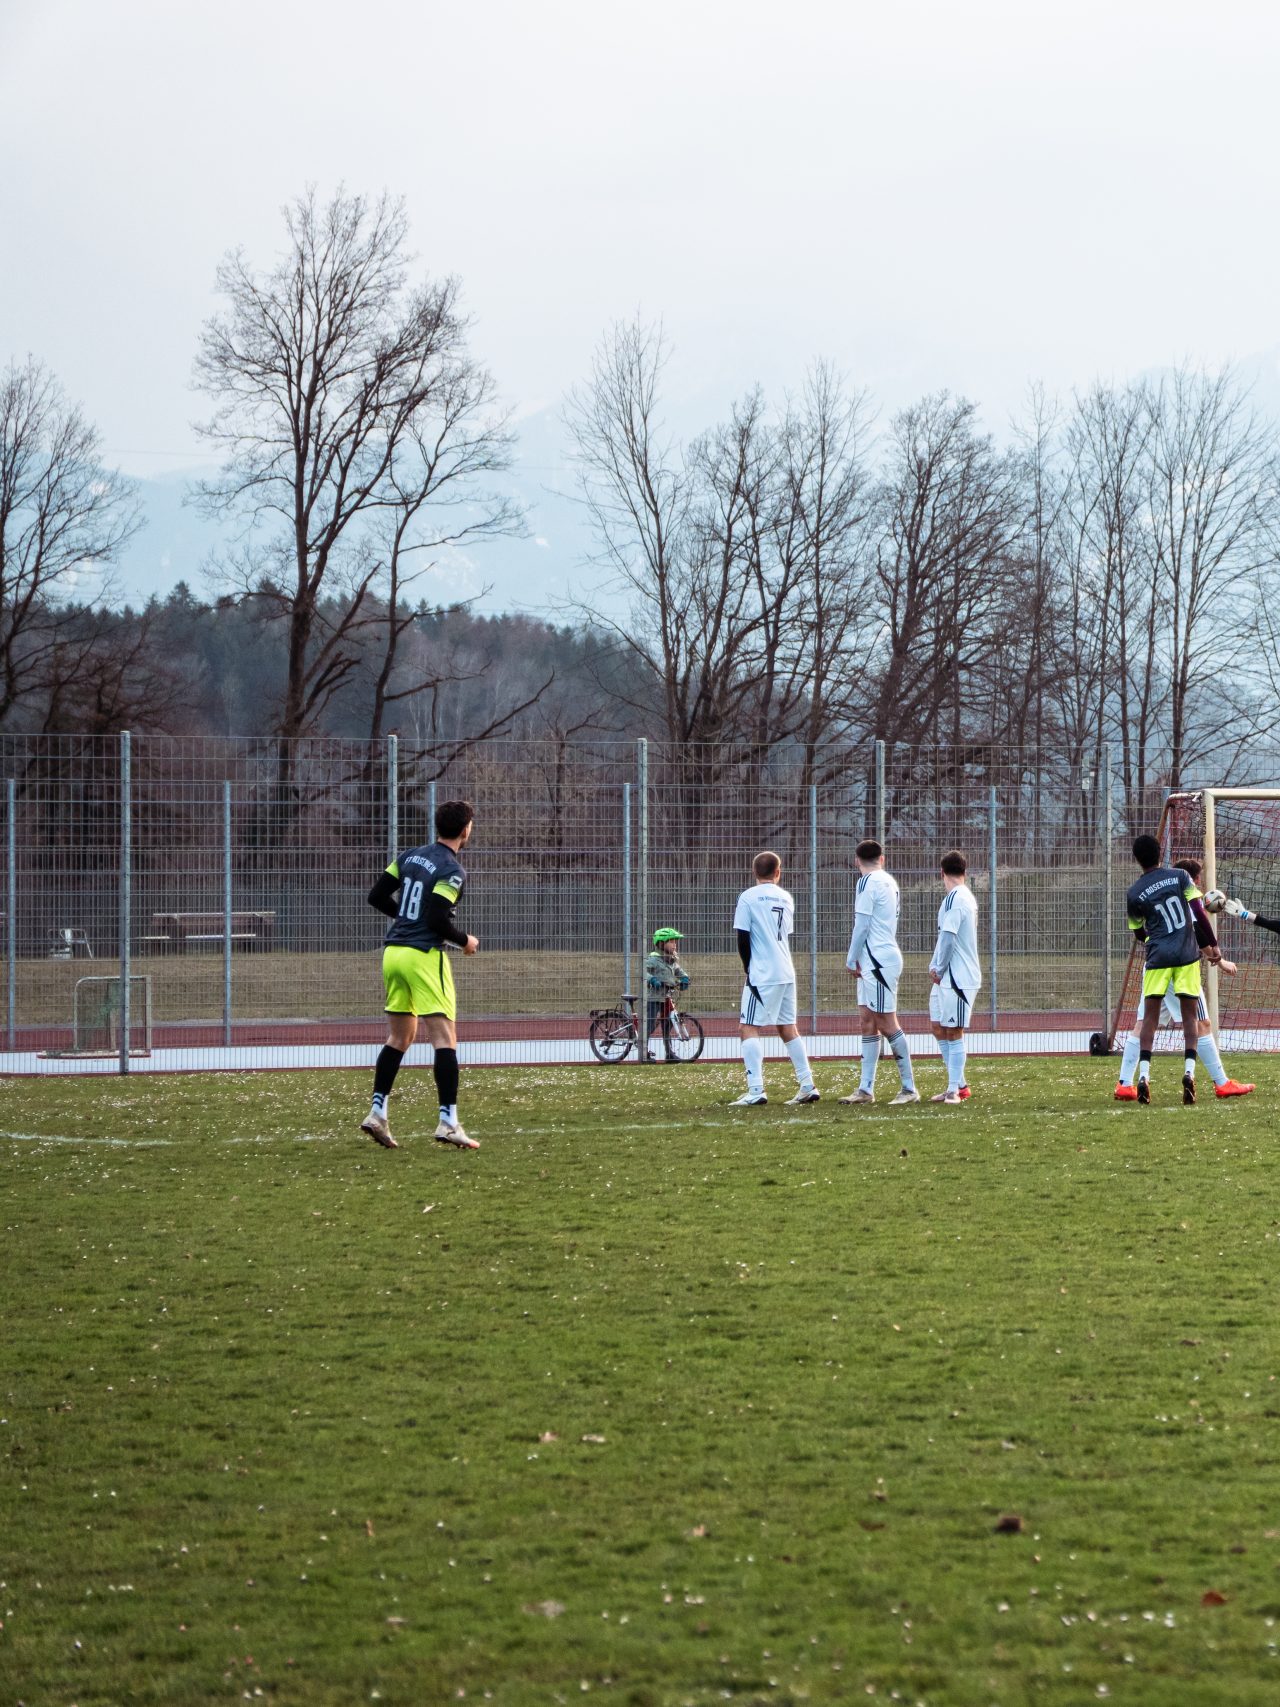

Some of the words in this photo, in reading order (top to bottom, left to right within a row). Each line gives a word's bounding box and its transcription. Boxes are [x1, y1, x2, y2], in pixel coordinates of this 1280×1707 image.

[399, 876, 424, 920] 18
[1138, 891, 1148, 902] FT
[1144, 876, 1179, 896] ROSENHEIM
[770, 906, 785, 942] 7
[1154, 895, 1186, 934] 10
